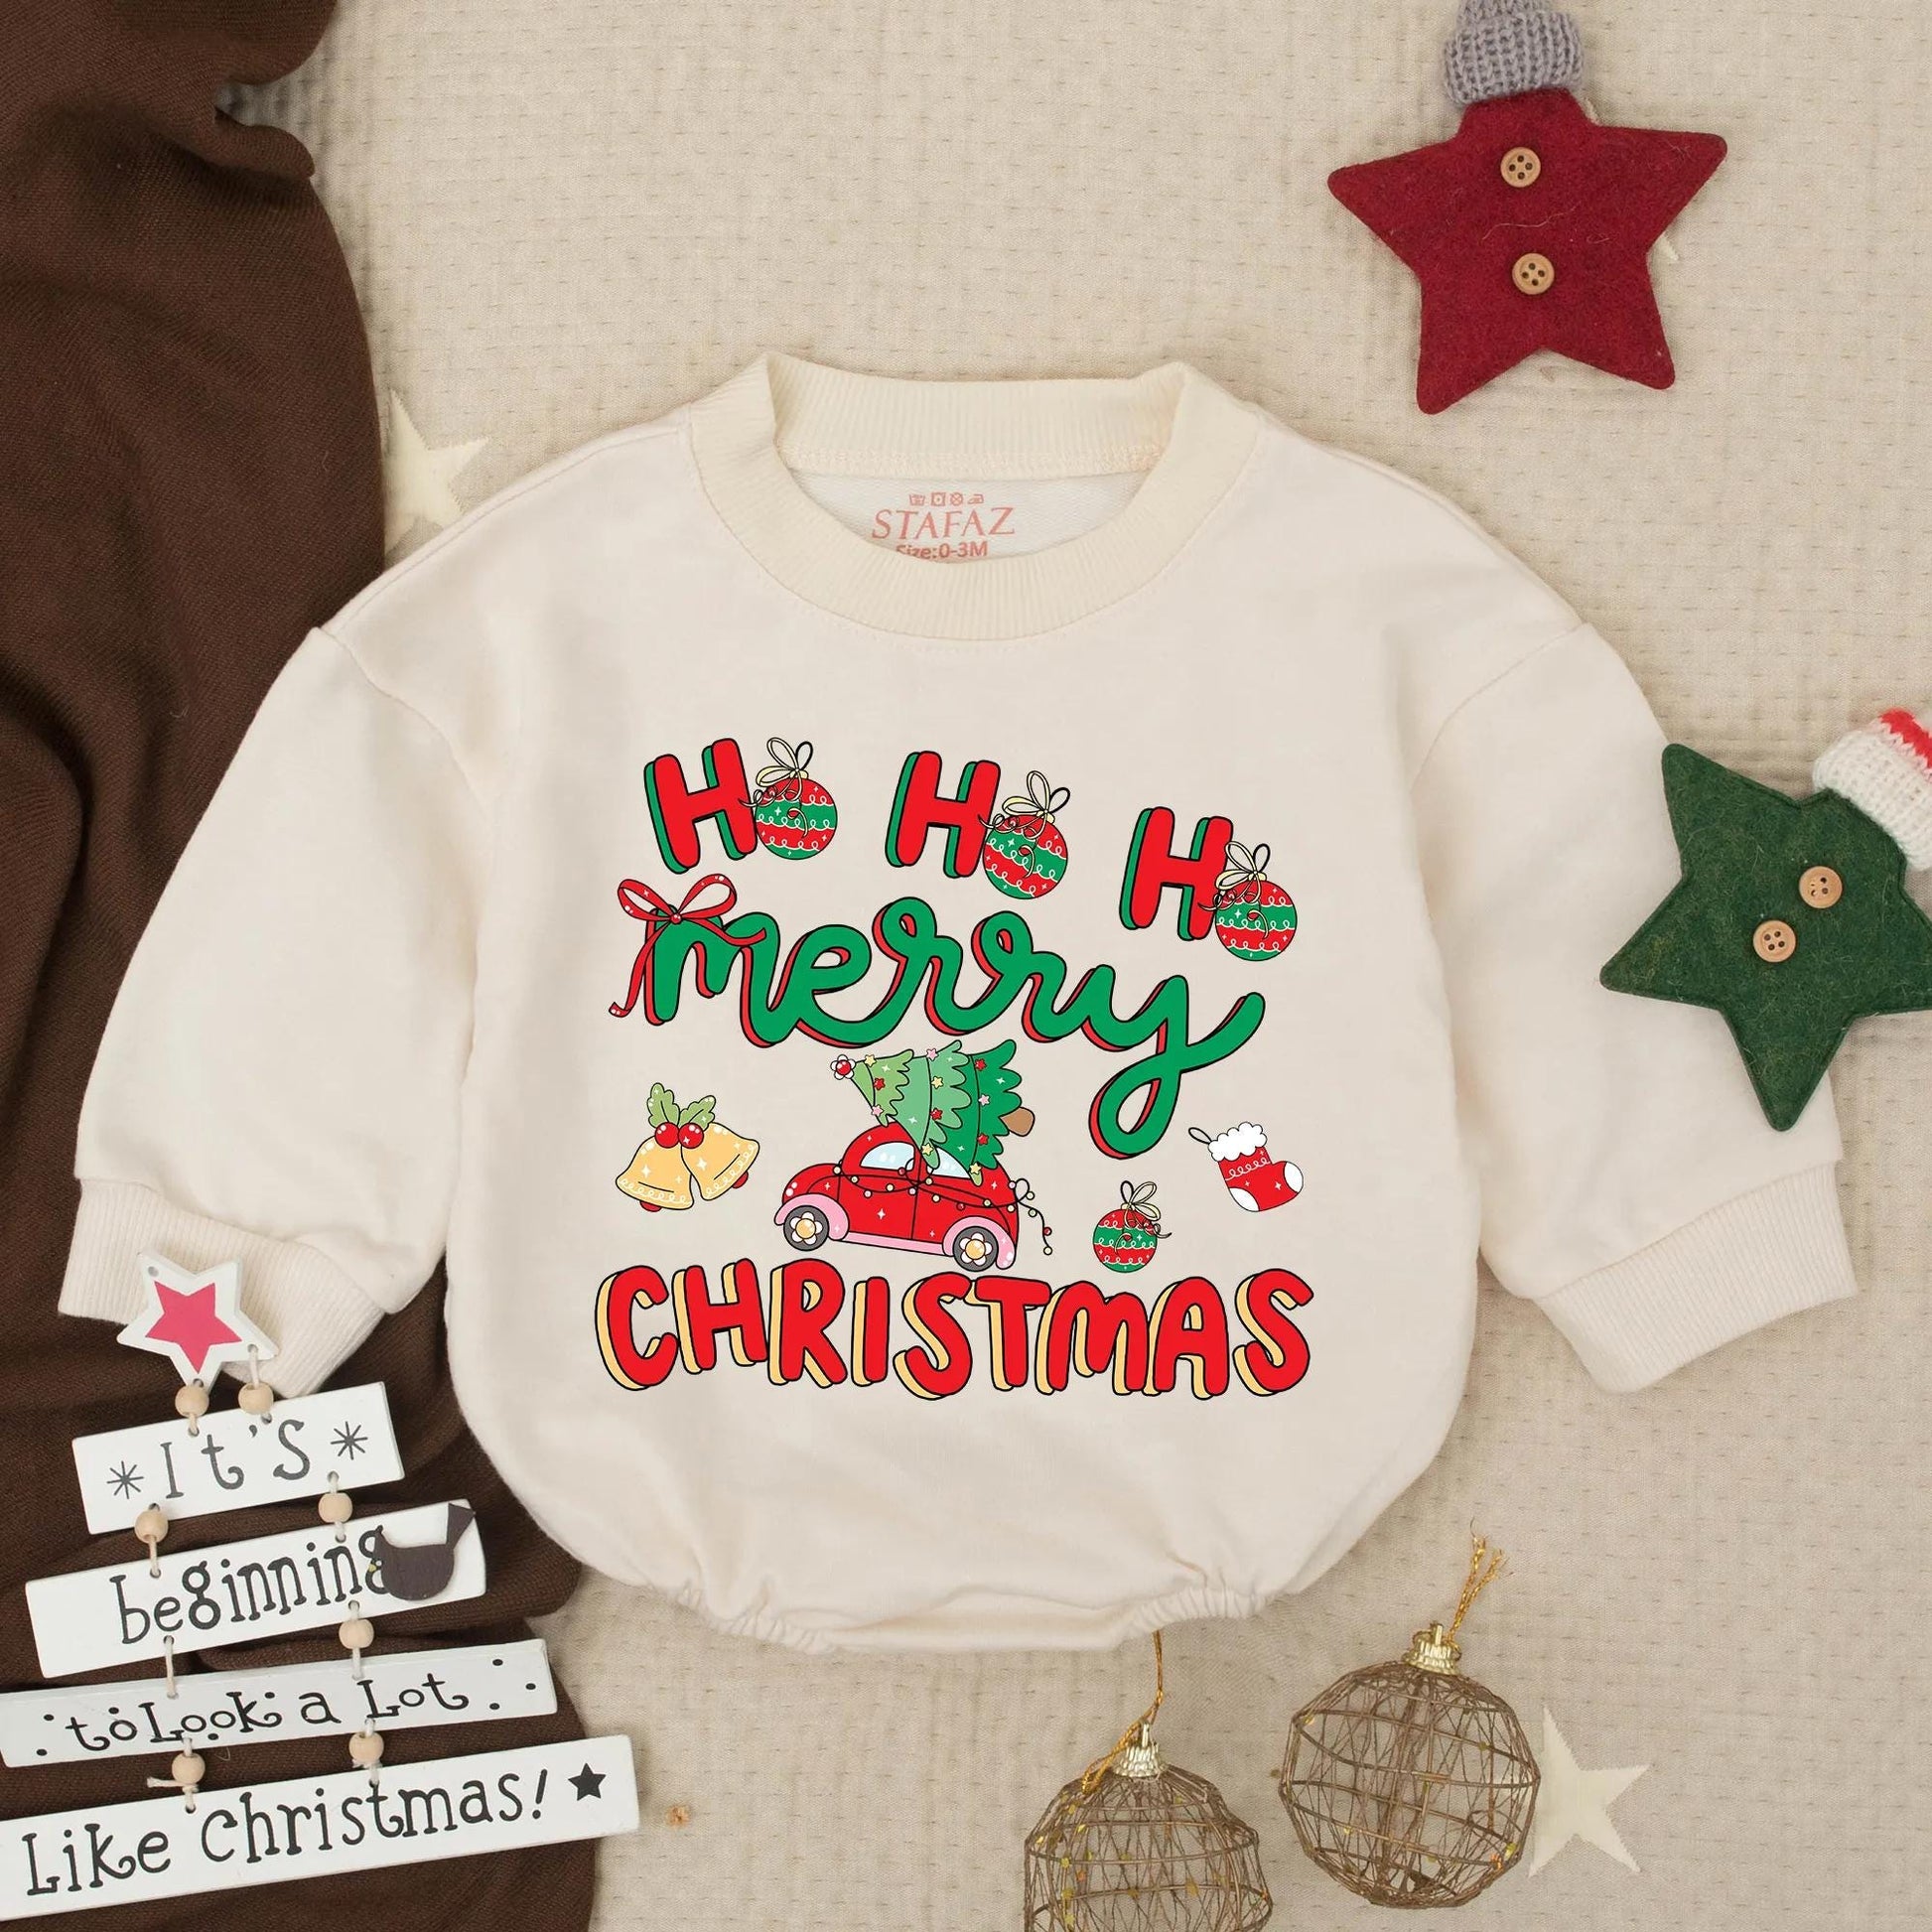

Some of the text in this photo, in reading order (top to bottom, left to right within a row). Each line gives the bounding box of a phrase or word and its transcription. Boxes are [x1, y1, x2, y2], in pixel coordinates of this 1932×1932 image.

[872, 506, 1015, 540] STAFAZ
[595, 1258, 1314, 1400] CHRISTMAS
[300, 1691, 342, 1725] a
[21, 1822, 171, 1897] Like
